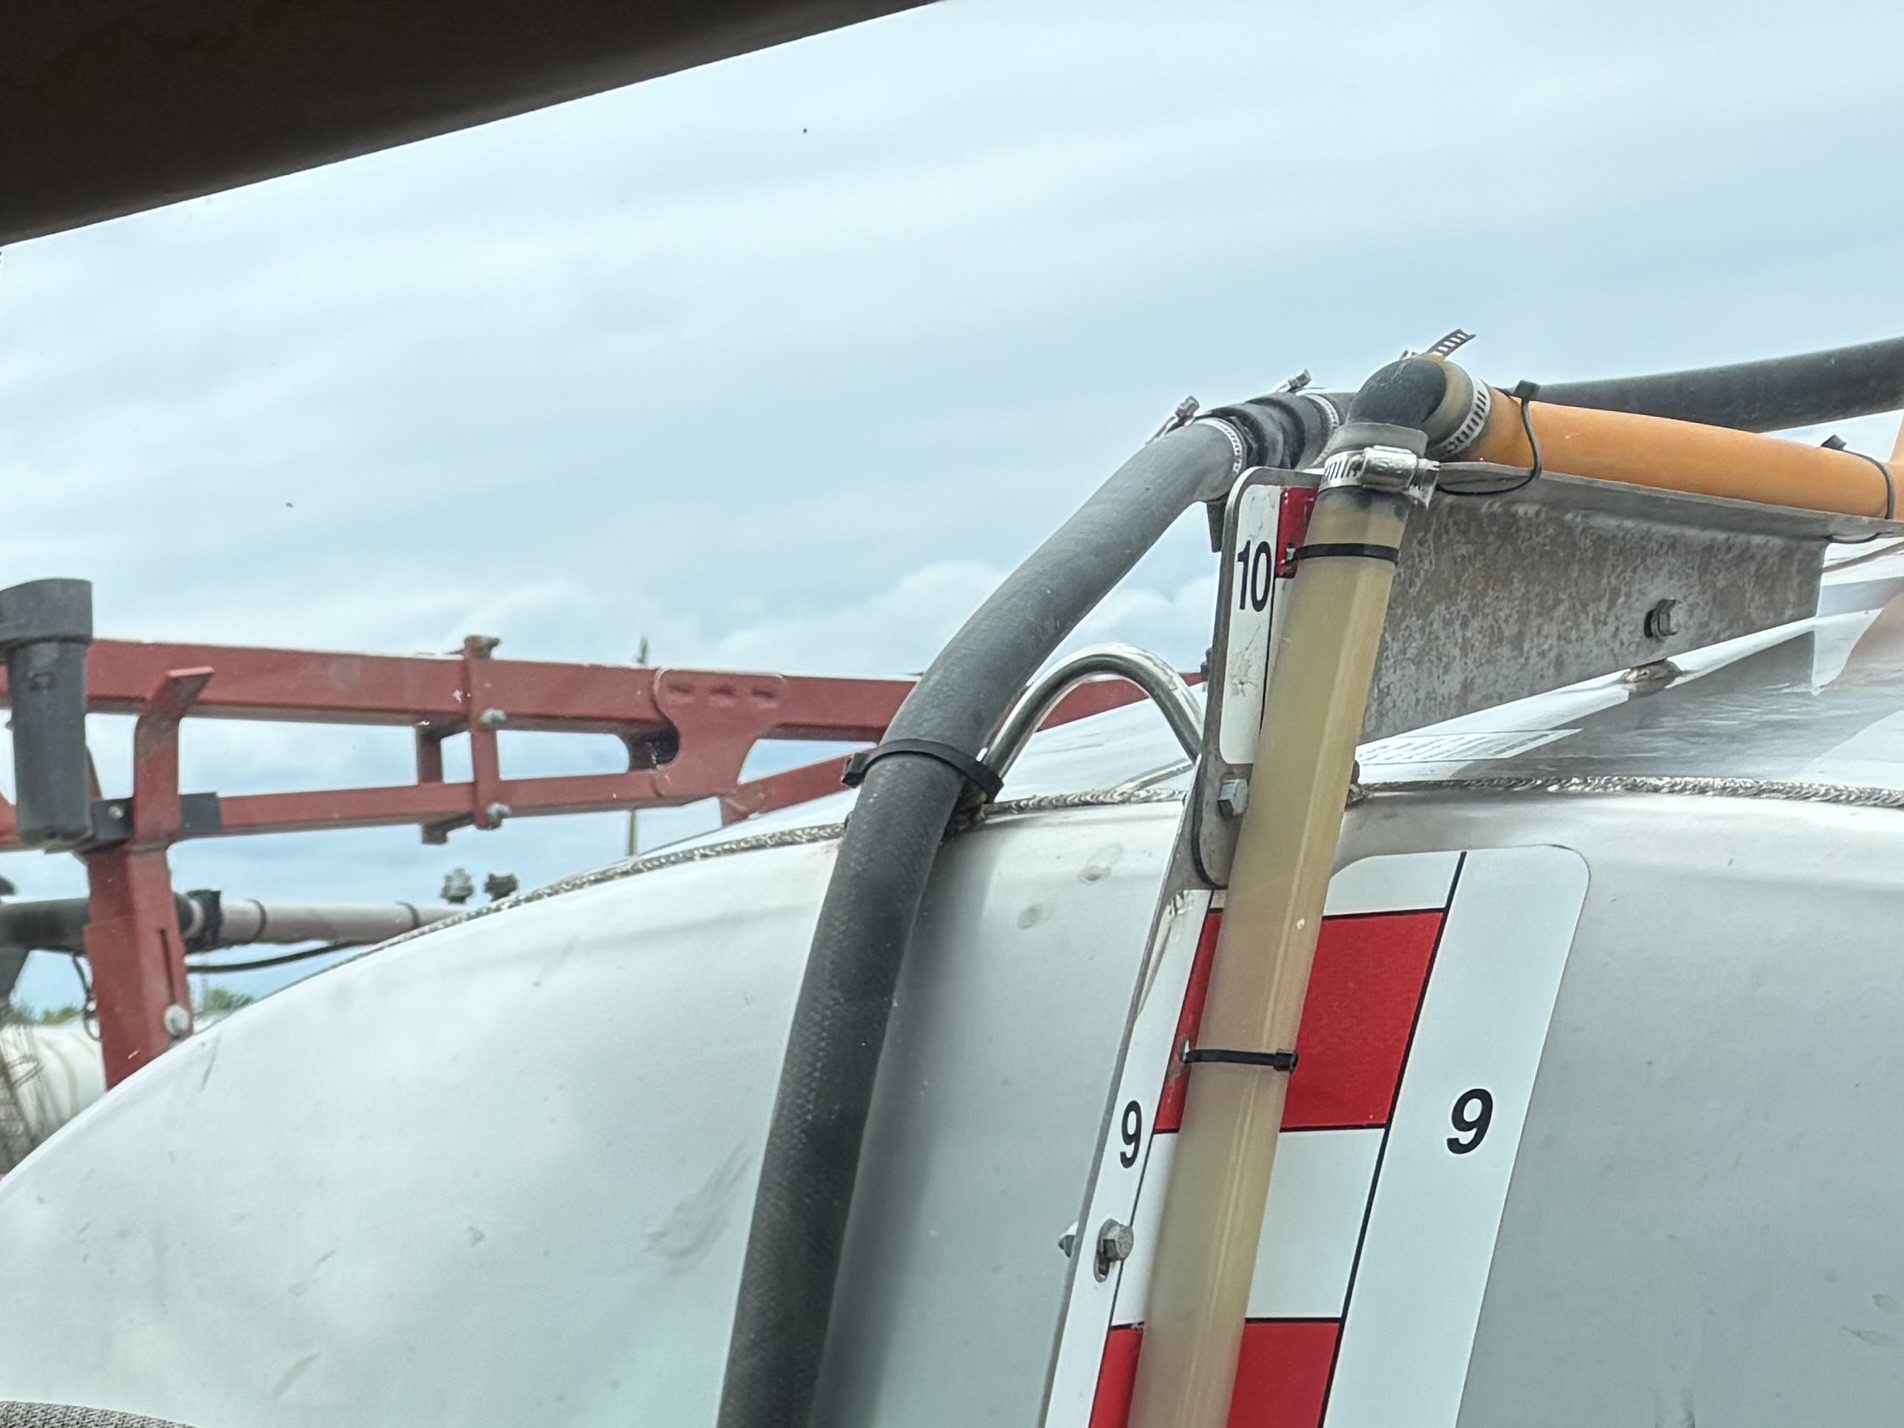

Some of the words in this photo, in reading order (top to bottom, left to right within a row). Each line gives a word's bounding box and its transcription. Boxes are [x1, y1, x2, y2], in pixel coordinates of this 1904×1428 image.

[1236, 540, 1273, 613] 10
[1119, 1100, 1142, 1168] 9
[1446, 1088, 1494, 1155] 9
